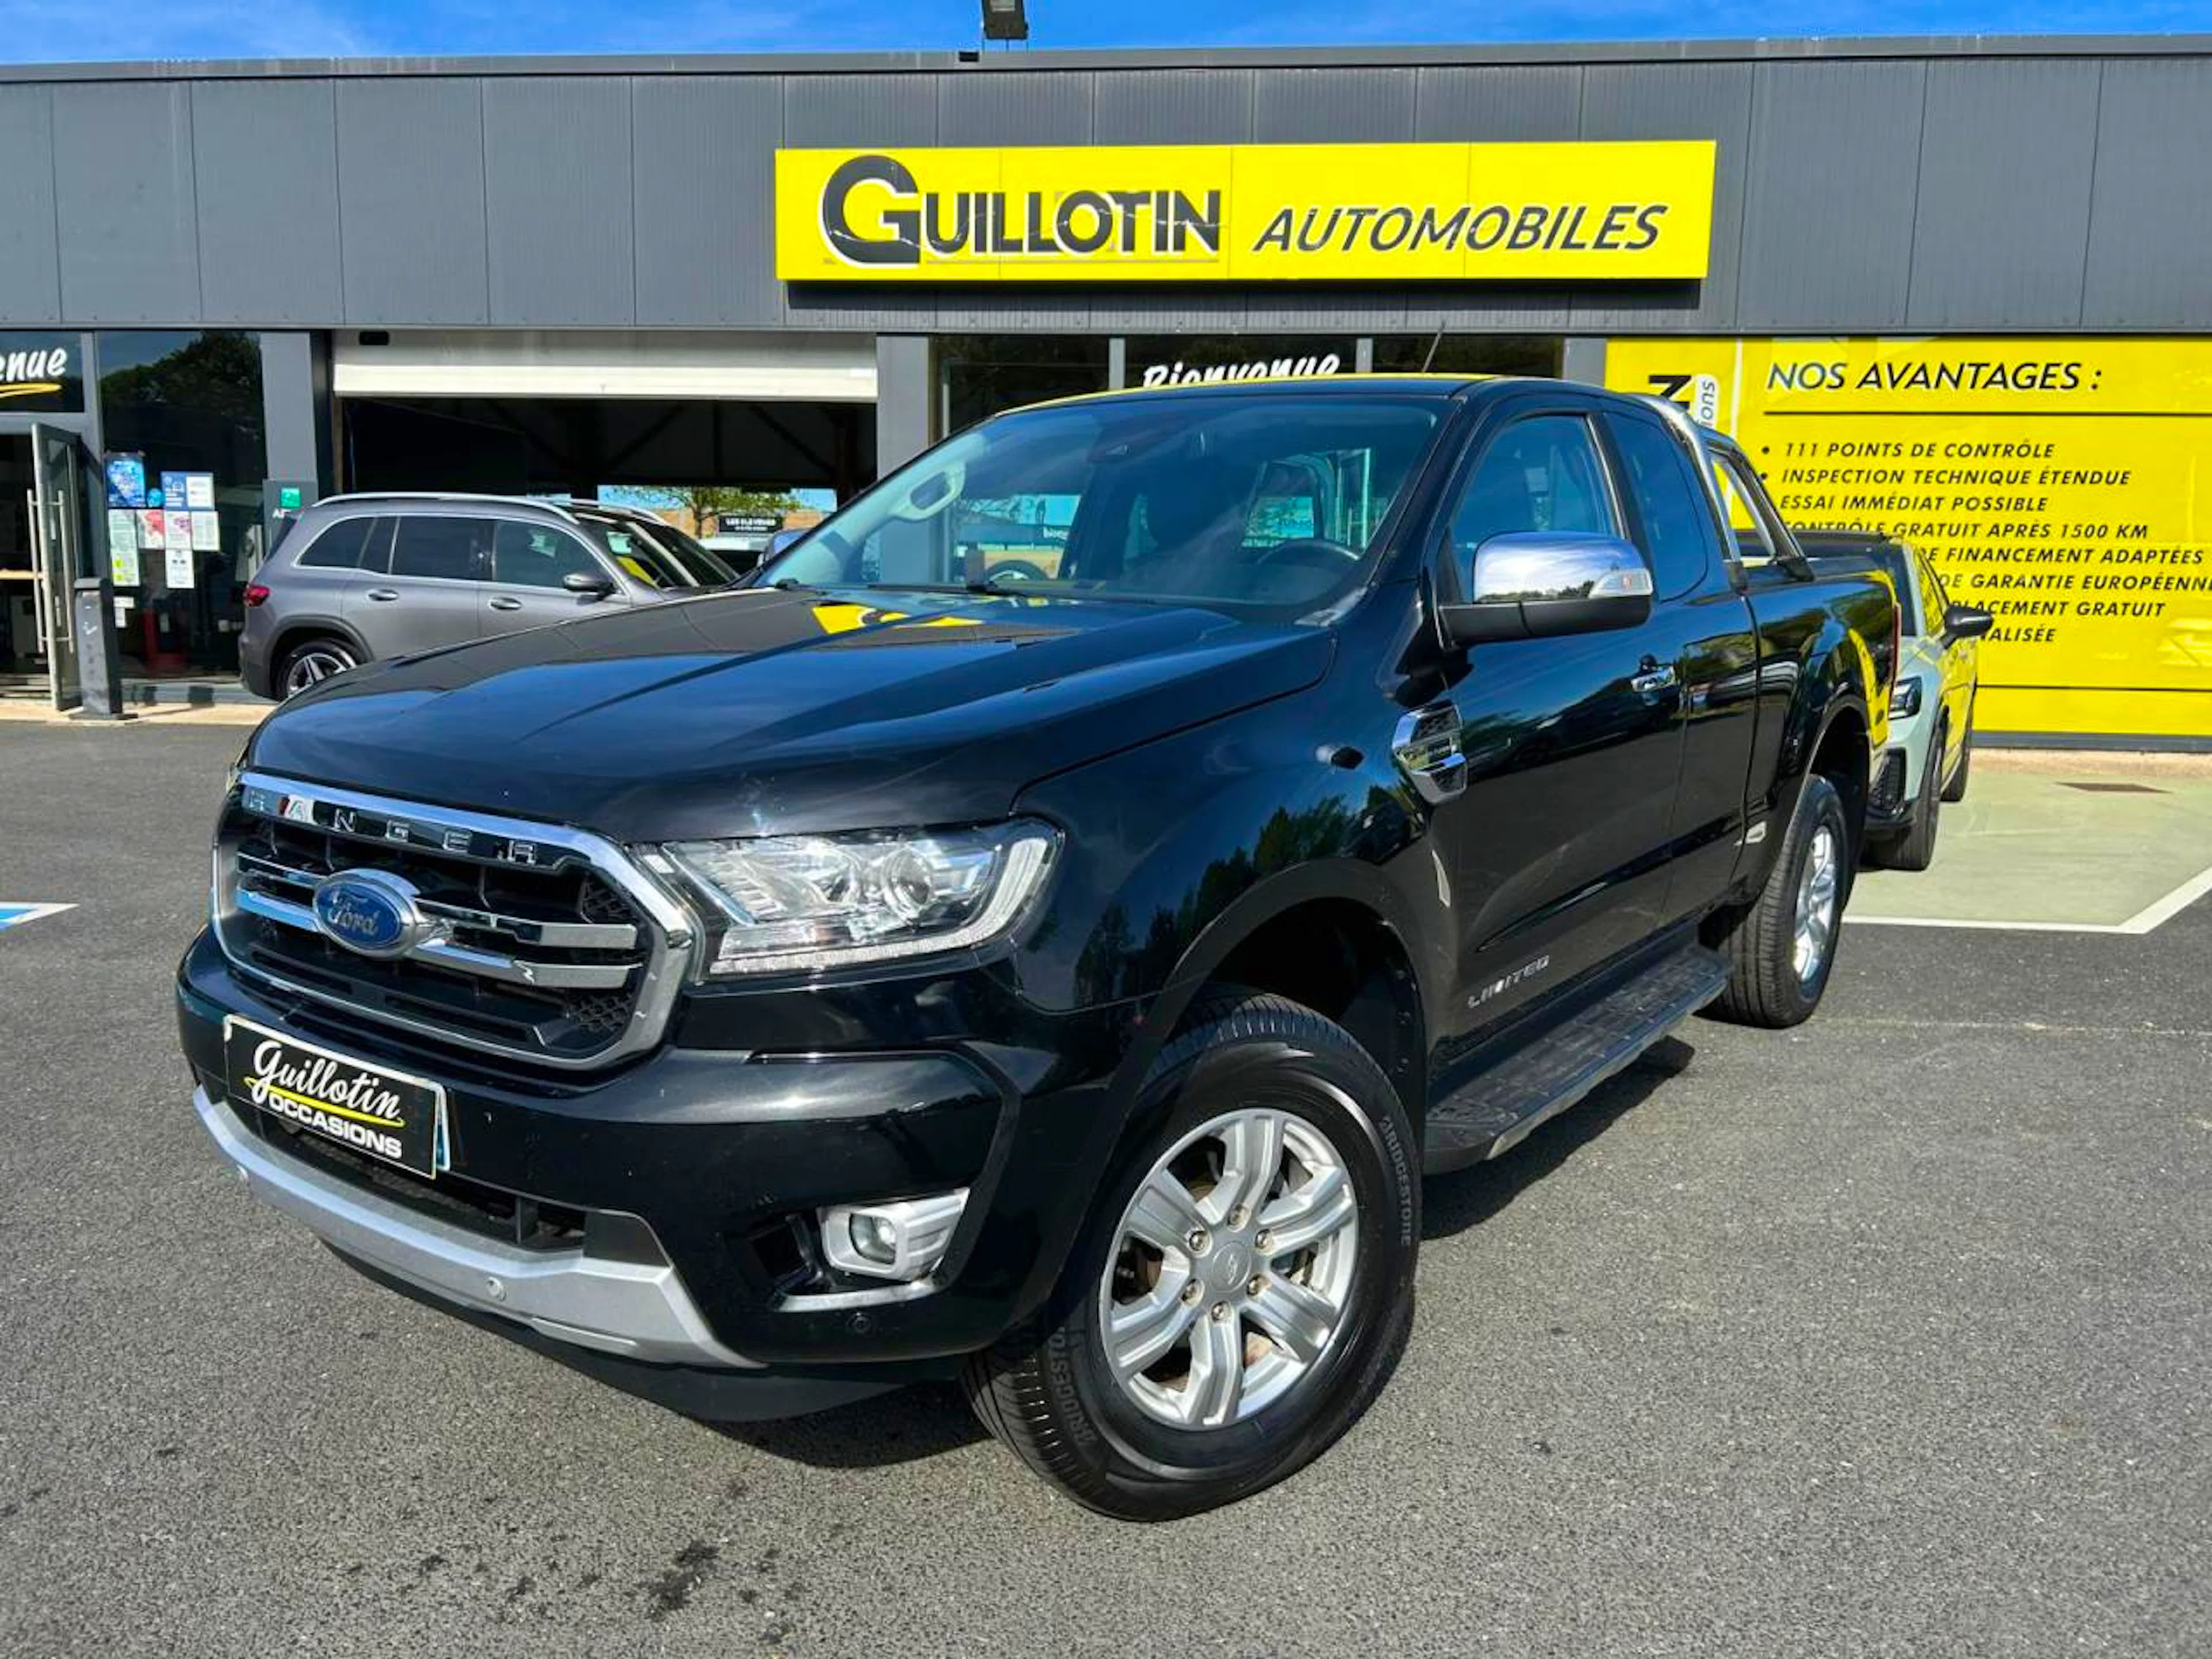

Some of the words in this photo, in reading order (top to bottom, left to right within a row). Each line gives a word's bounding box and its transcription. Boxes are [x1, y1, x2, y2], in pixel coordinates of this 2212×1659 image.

[822, 154, 1221, 263] GUILLOTIN
[1252, 205, 1669, 252] AUTOMOBILES
[0, 347, 67, 382] nue
[1766, 362, 1847, 390] NOS
[1855, 362, 2082, 391] AVANTAGES
[1786, 442, 1818, 457] 111
[1827, 442, 1904, 457] POINTS
[1910, 443, 1937, 457] DE
[1944, 438, 2055, 458] CONTRÔLE
[1781, 469, 1905, 484] INSPECTION
[1912, 470, 2032, 486] TECHNIQUE
[2038, 465, 2131, 485] ÉTENDUE
[1779, 495, 1835, 510] ESSAI
[1843, 492, 1945, 510] IMMÉDIAT
[1951, 497, 2048, 512] POSSIBLE
[1785, 517, 1886, 532] ONTRÔLE
[1893, 522, 1982, 538] GRATUIT
[1987, 518, 2052, 538] APRÈS
[2061, 523, 2108, 539] 1500
[2116, 524, 2149, 539] KM
[1946, 547, 2094, 563] FINANCEMENT
[2100, 545, 2205, 564] ADAPTÉES
[1971, 573, 2074, 589] GARANTIE
[2075, 601, 2166, 617] GRATUIT
[1979, 624, 2057, 642] ALISÉE
[326, 886, 380, 938] Ford
[251, 1039, 402, 1120] Guillotin
[268, 1093, 403, 1159] OCCASIONS
[1048, 1326, 1097, 1445] BRIDGESTO
